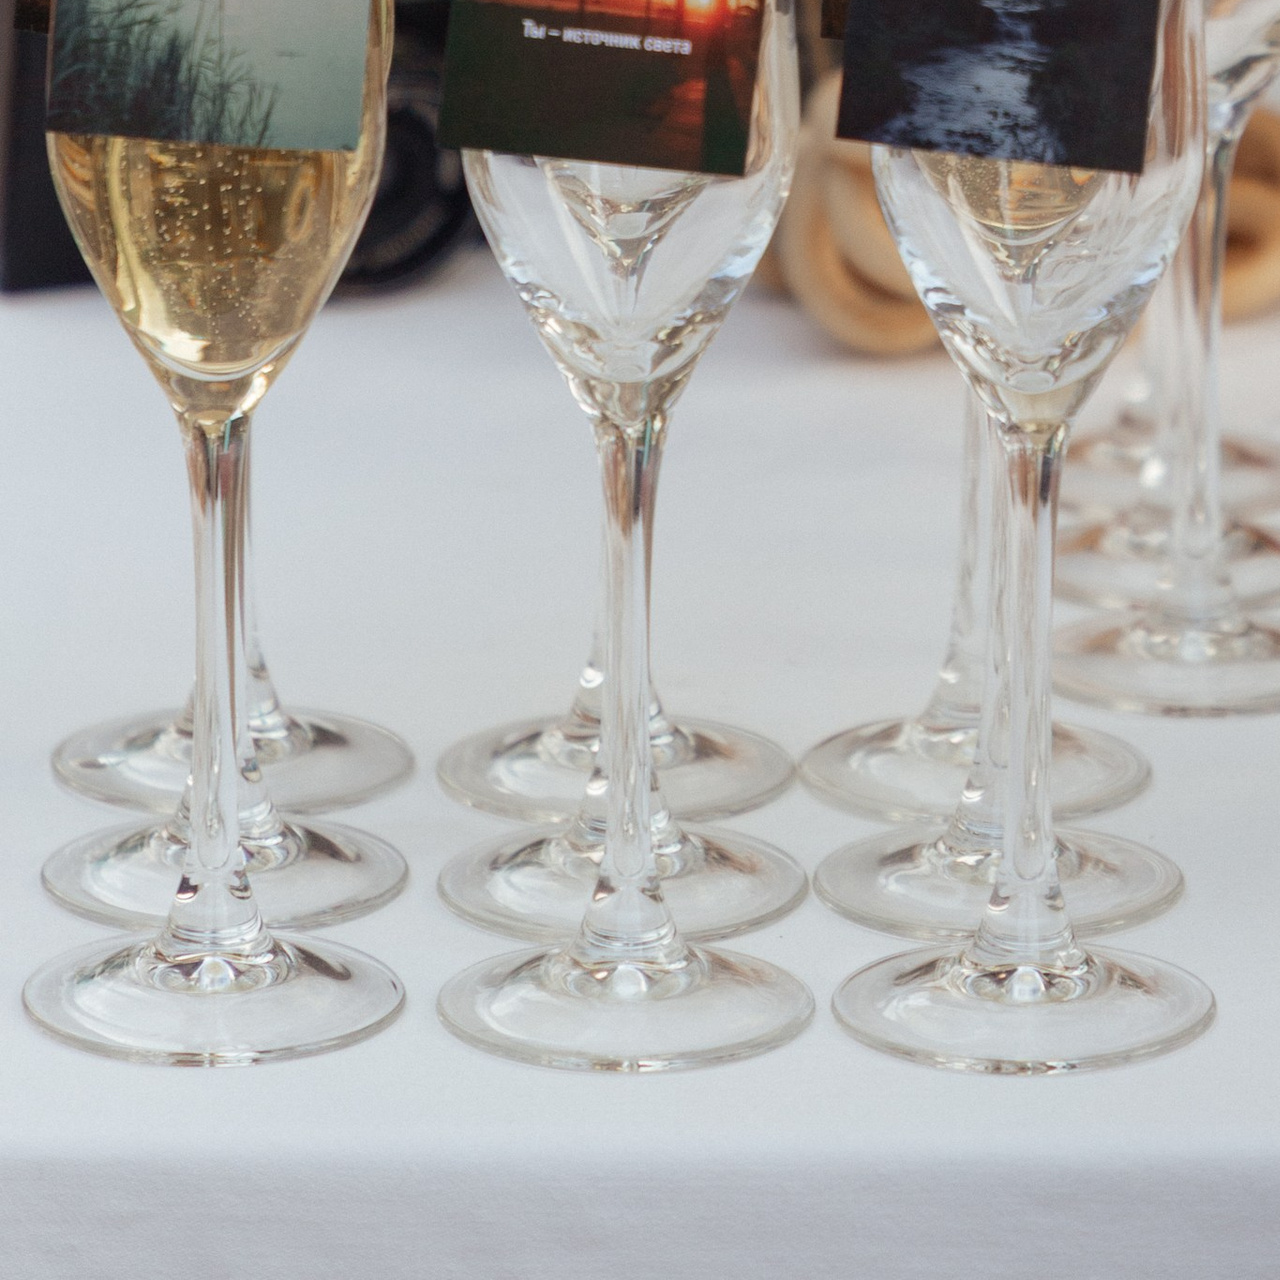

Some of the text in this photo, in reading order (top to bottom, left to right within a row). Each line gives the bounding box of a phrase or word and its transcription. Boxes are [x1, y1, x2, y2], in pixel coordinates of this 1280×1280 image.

[522, 17, 547, 39] Ты
[562, 26, 643, 50] источник
[643, 35, 693, 56] света
